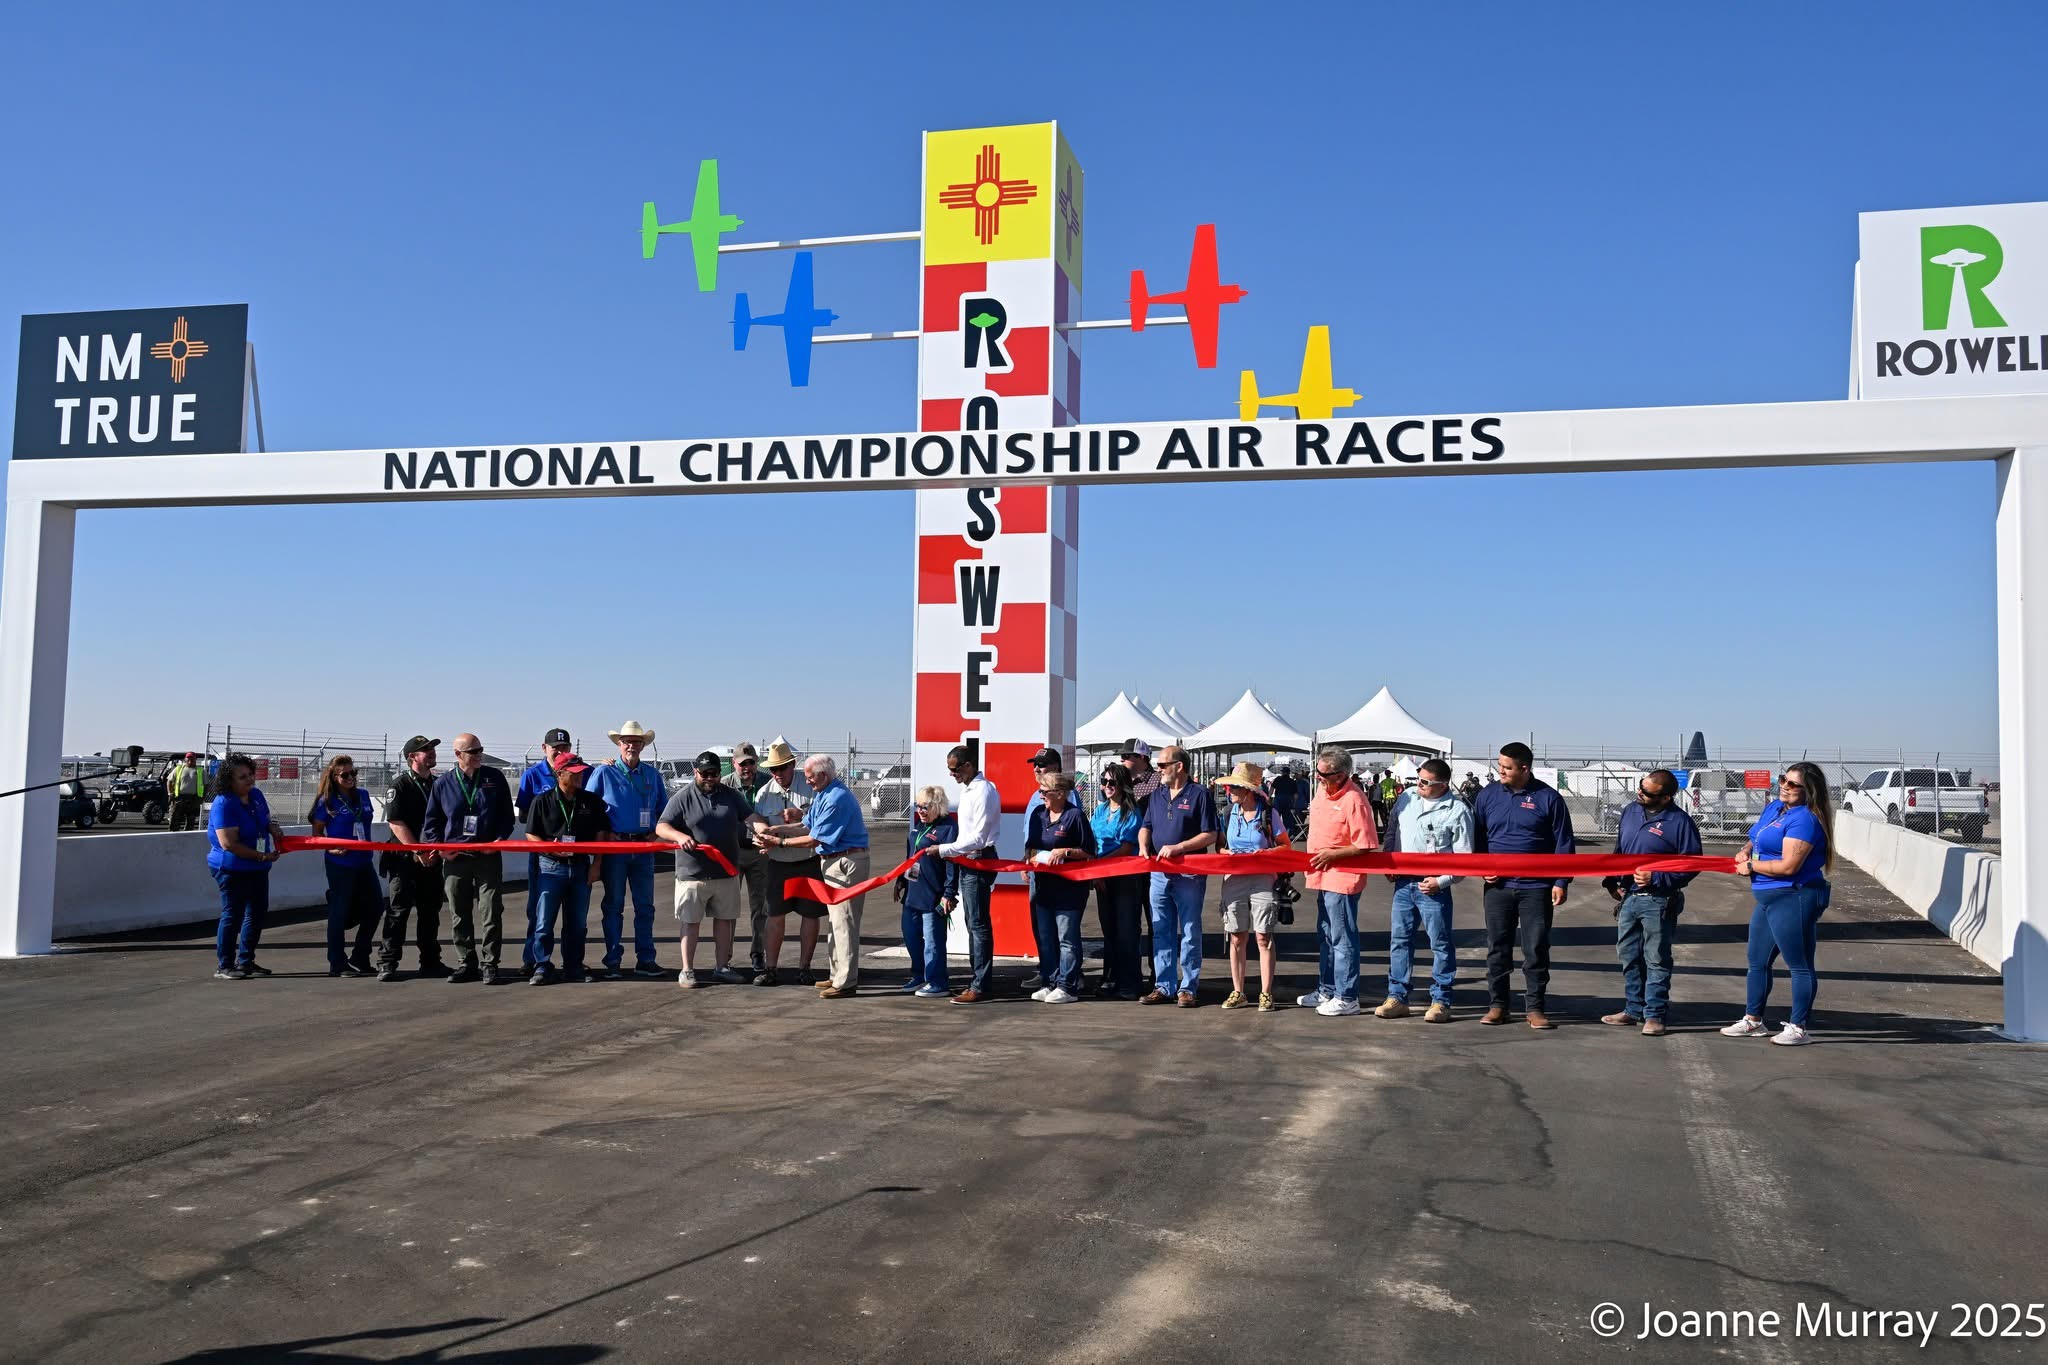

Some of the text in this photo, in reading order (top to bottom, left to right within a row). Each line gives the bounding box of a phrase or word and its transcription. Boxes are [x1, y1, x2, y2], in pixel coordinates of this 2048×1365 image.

[55, 332, 142, 383] NM
[54, 393, 197, 445] TRUE
[384, 417, 1505, 490] NATIONAL CHAMPIONSHIP AIR RACES
